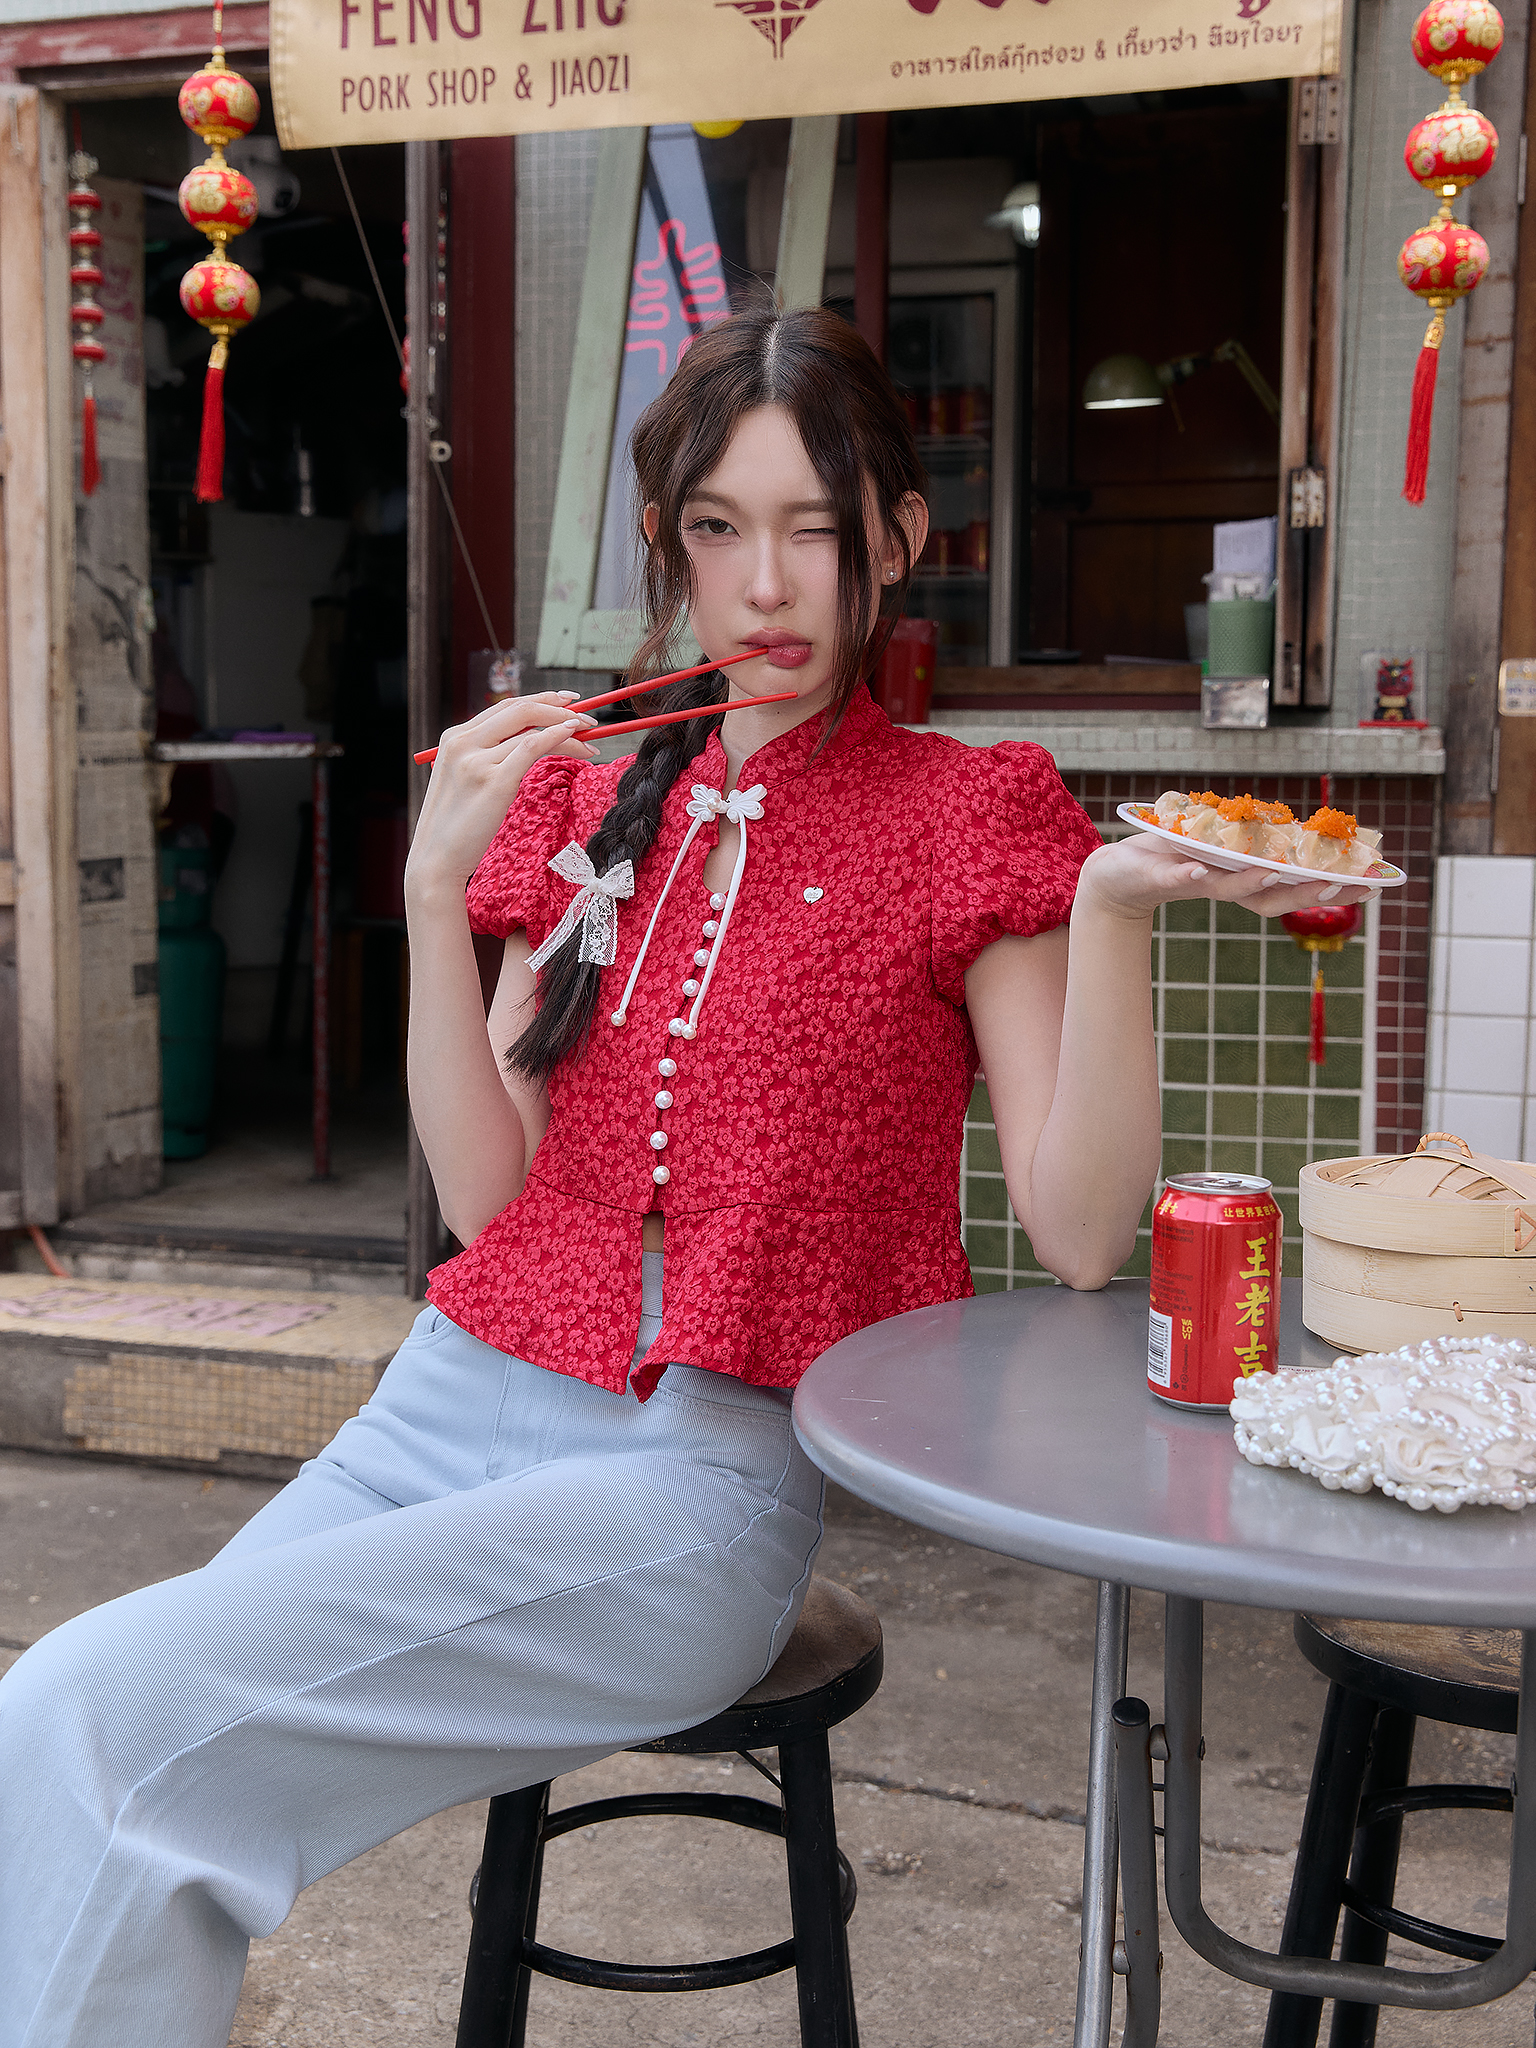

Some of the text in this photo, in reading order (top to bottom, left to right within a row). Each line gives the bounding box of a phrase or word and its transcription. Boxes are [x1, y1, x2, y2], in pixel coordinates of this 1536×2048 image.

[341, 54, 630, 113] PORK SHOP & JIAOZI
[1233, 1236, 1271, 1378] 王老吉
